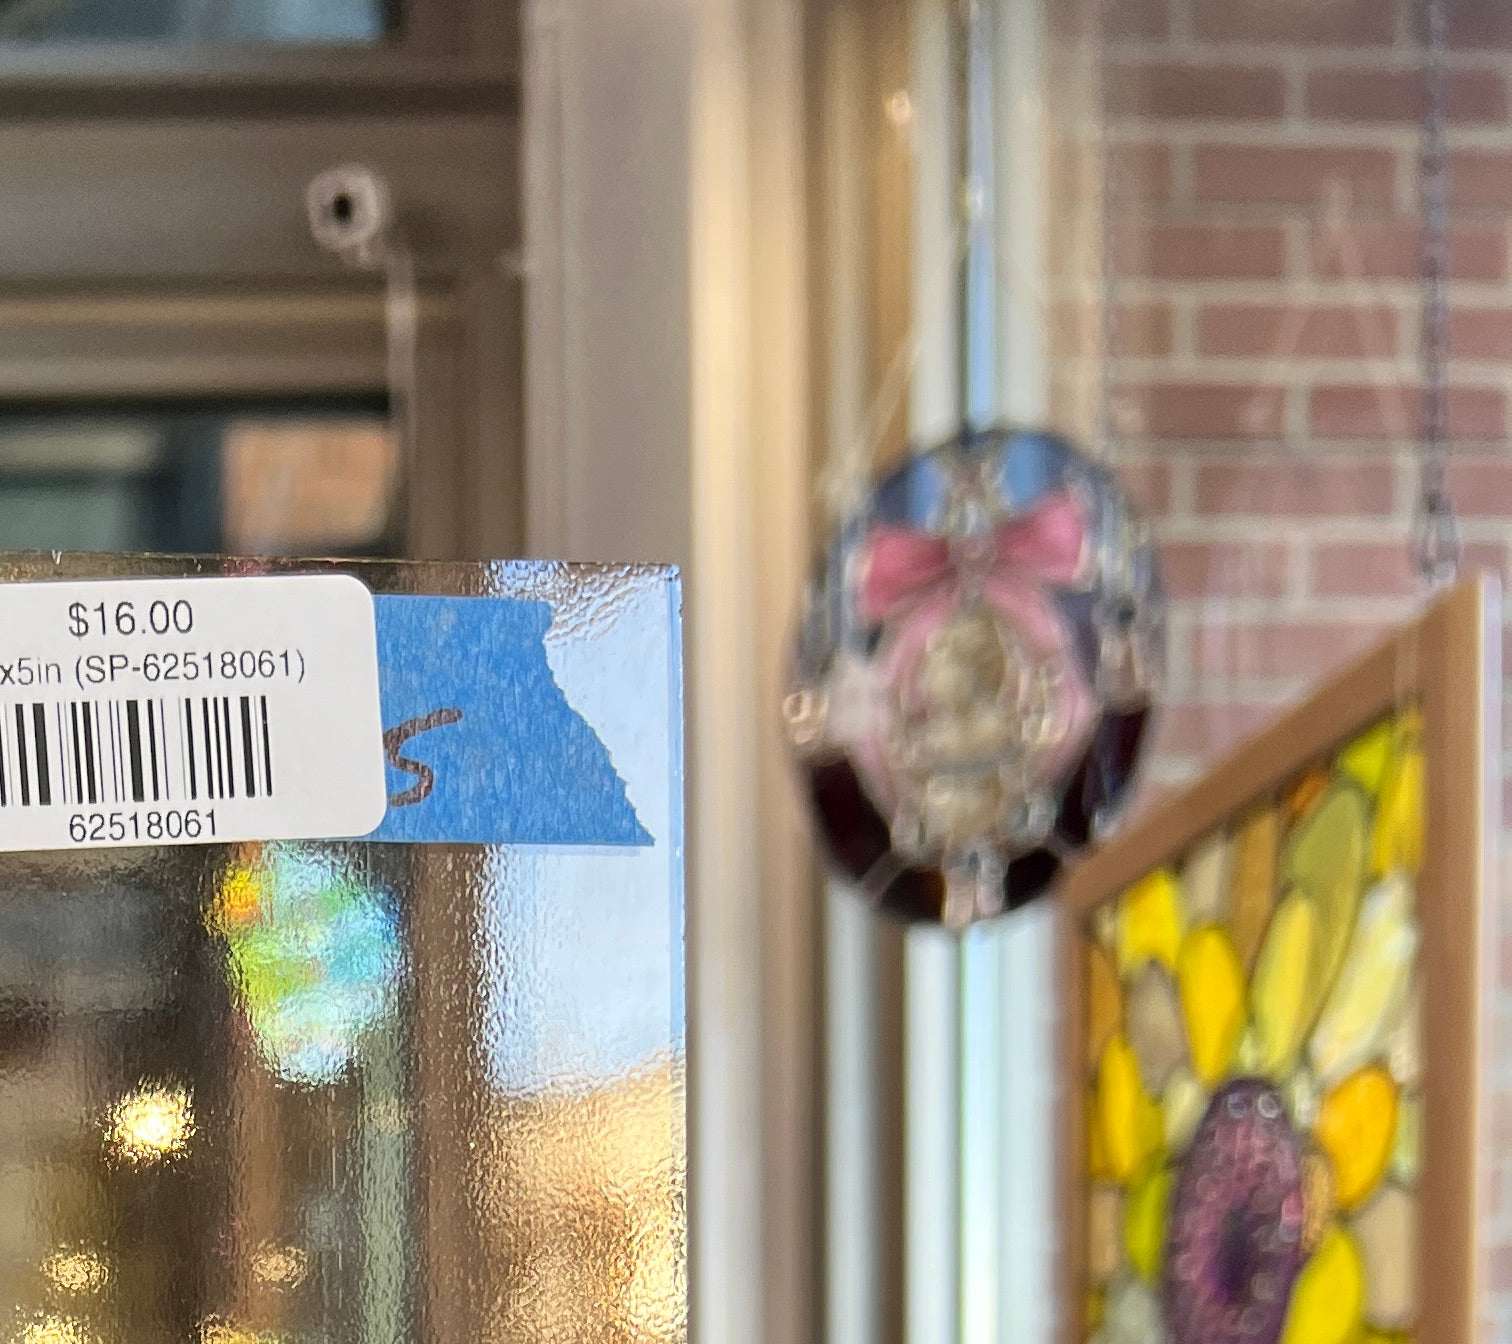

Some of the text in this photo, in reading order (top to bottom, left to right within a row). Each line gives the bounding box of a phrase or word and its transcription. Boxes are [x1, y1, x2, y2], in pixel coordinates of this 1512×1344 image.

[68, 599, 194, 639] $16.00
[74, 649, 306, 692] (SP-62518061)
[68, 808, 217, 843] 62518061
